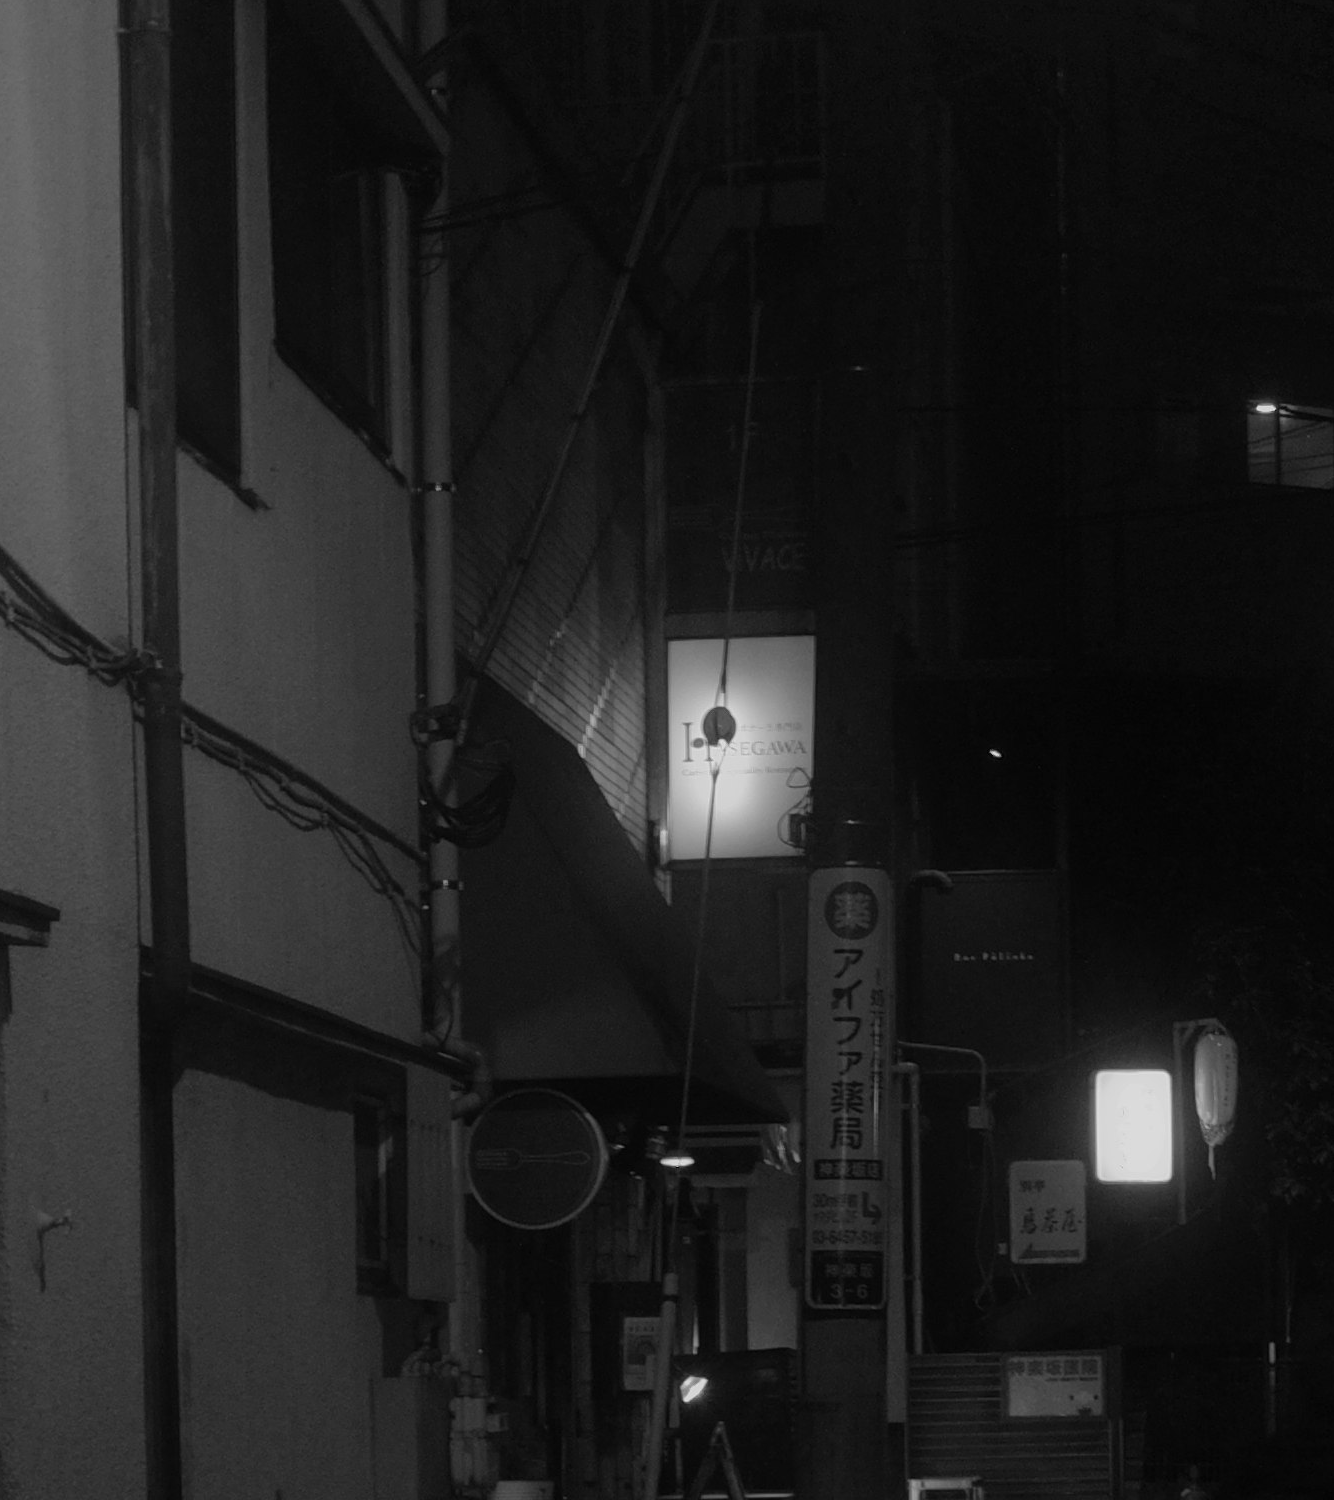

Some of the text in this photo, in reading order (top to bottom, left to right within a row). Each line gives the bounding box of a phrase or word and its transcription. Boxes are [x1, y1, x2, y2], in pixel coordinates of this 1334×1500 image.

[831, 948, 865, 1150] アイファ薬局
[829, 1283, 869, 1299] 3-6
